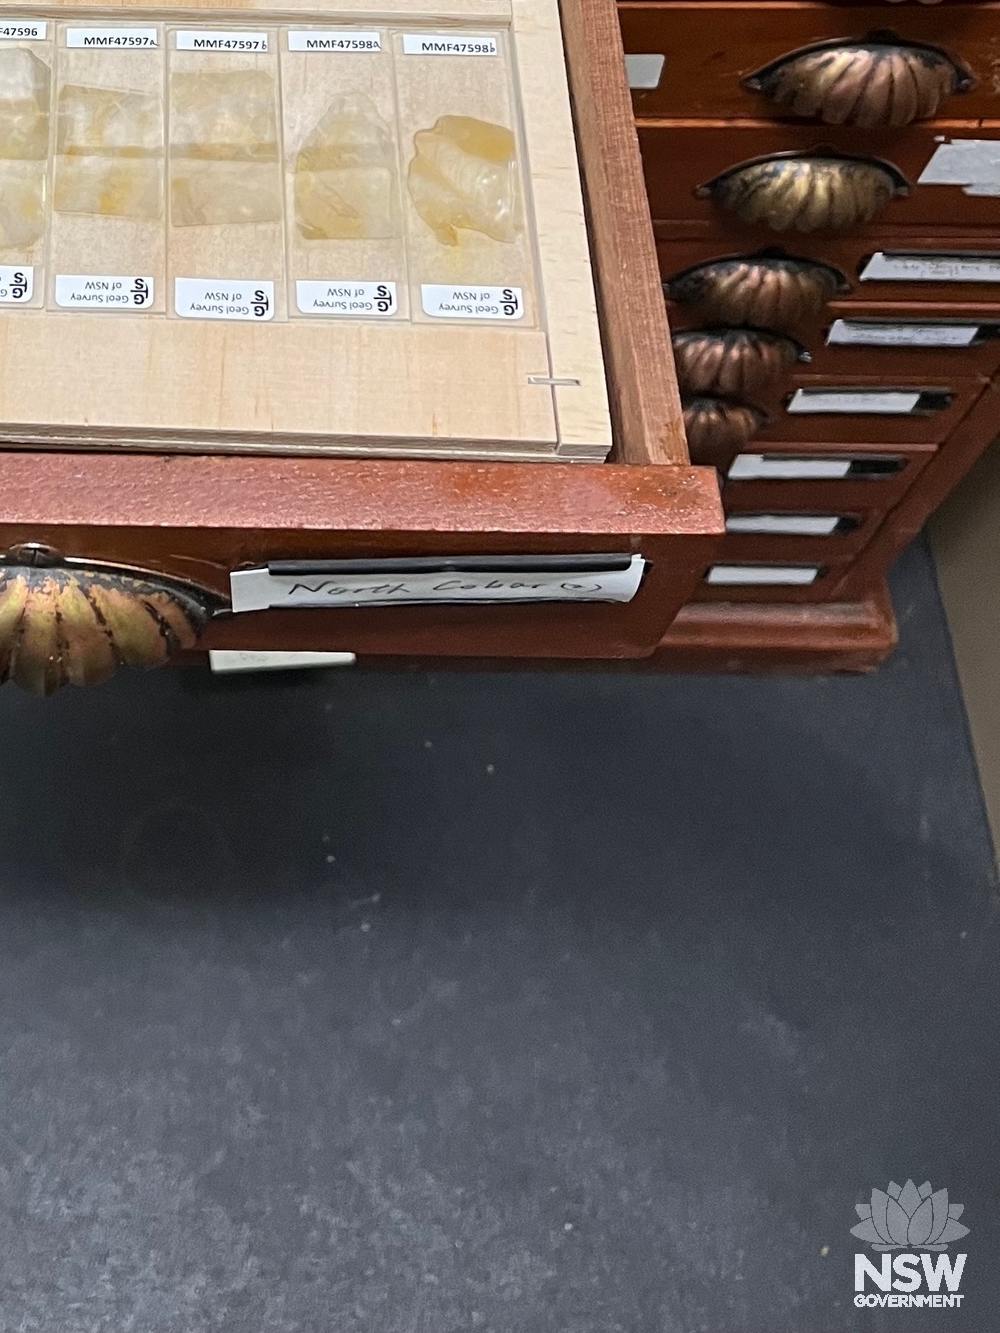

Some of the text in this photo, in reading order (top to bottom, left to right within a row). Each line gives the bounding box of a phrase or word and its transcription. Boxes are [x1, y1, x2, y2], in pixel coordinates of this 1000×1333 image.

[84, 281, 123, 291] of NSW
[70, 292, 129, 304] Geol Survey
[204, 292, 243, 302] of NSW
[327, 288, 365, 298] of NSW
[452, 291, 491, 302] of NSW
[189, 303, 250, 315] Geol Survey
[313, 299, 373, 311] Geol Survey
[438, 303, 499, 315] Geol Survey
[288, 581, 410, 597] North
